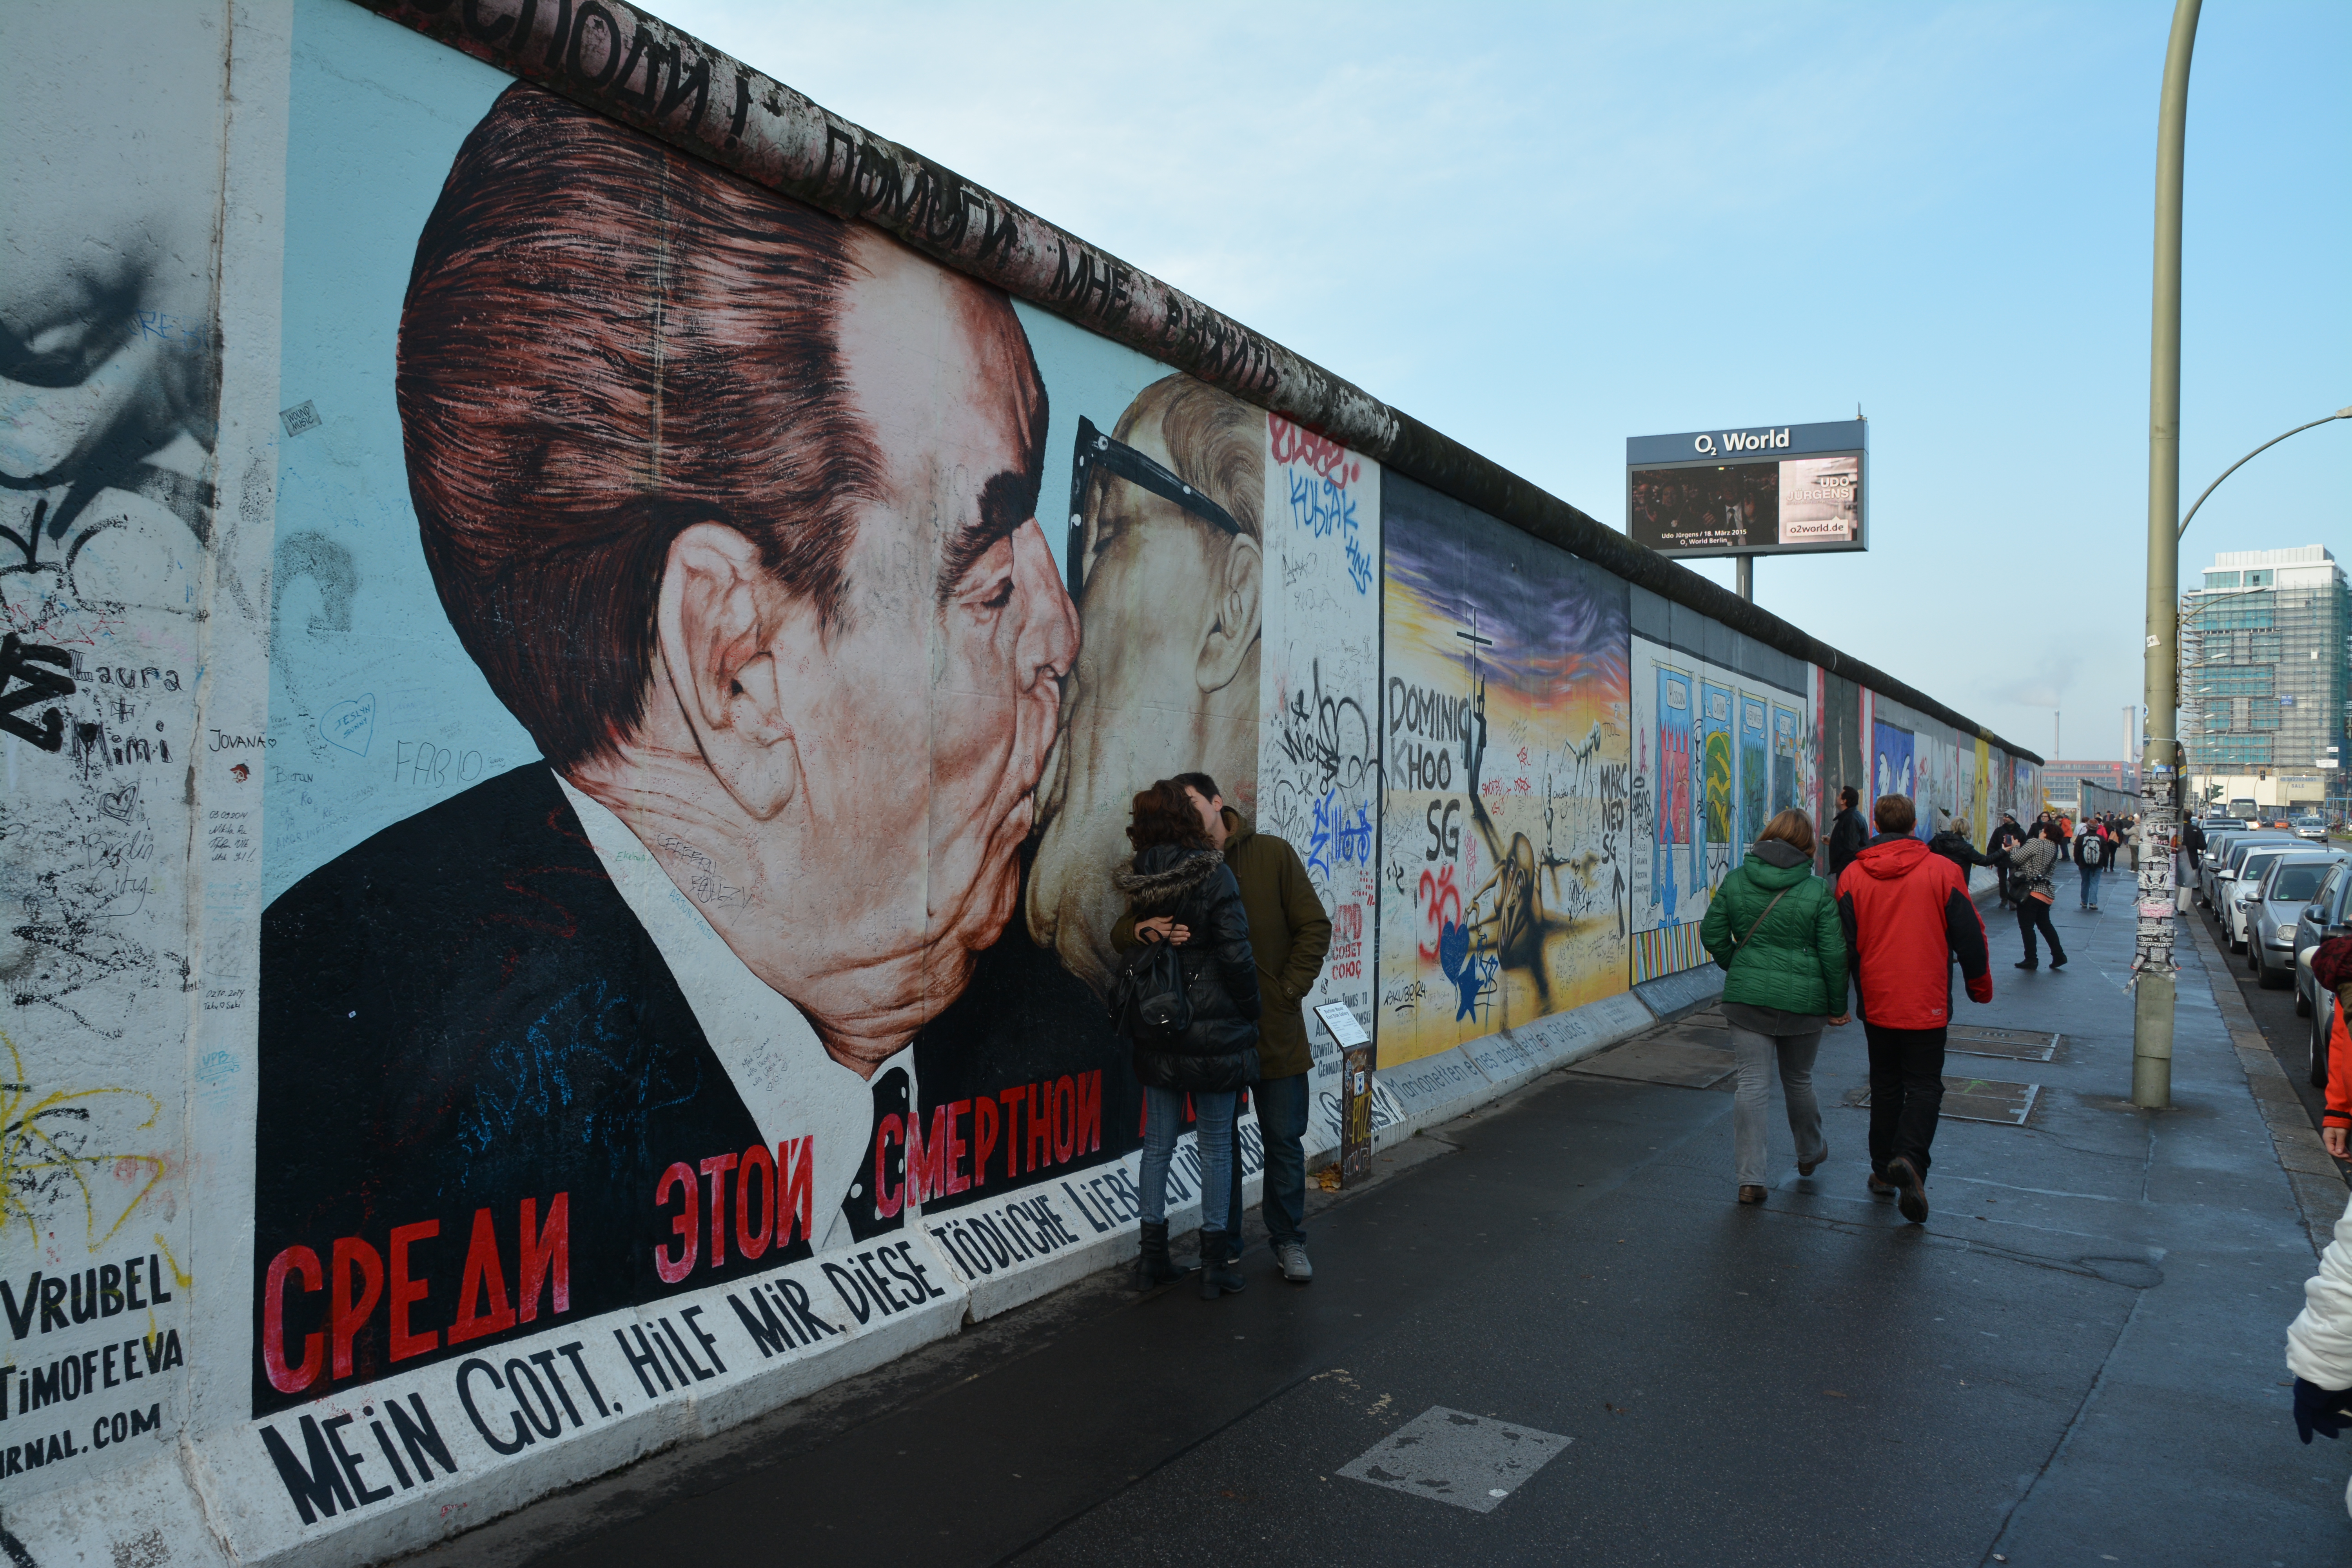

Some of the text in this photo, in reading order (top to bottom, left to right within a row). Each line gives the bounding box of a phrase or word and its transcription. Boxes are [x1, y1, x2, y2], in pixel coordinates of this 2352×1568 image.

[1049, 238, 1133, 319] МНЕ
[286, 405, 310, 423] WOUND
[292, 415, 314, 431] MUSIC
[1722, 428, 1789, 451] World
[1786, 488, 1849, 501] JÜRGENS
[1820, 476, 1849, 487] UDO
[1790, 523, 1844, 534] o2world.de
[67, 649, 184, 692] Laura
[334, 704, 370, 731] JESLYN
[343, 717, 367, 739] SUNNY
[71, 717, 173, 771] Mimi
[209, 729, 266, 751] JOVANA
[395, 740, 482, 788] FABIO
[1390, 737, 1451, 793] KHOO
[1600, 763, 1628, 804] MARC
[1426, 799, 1461, 864] SG
[1602, 798, 1624, 833] NEO
[81, 831, 154, 870] Berlin
[1362, 991, 1368, 1005] TO
[0, 1254, 171, 1341] VRUBEL
[263, 1192, 570, 1394] СРЕДИ
